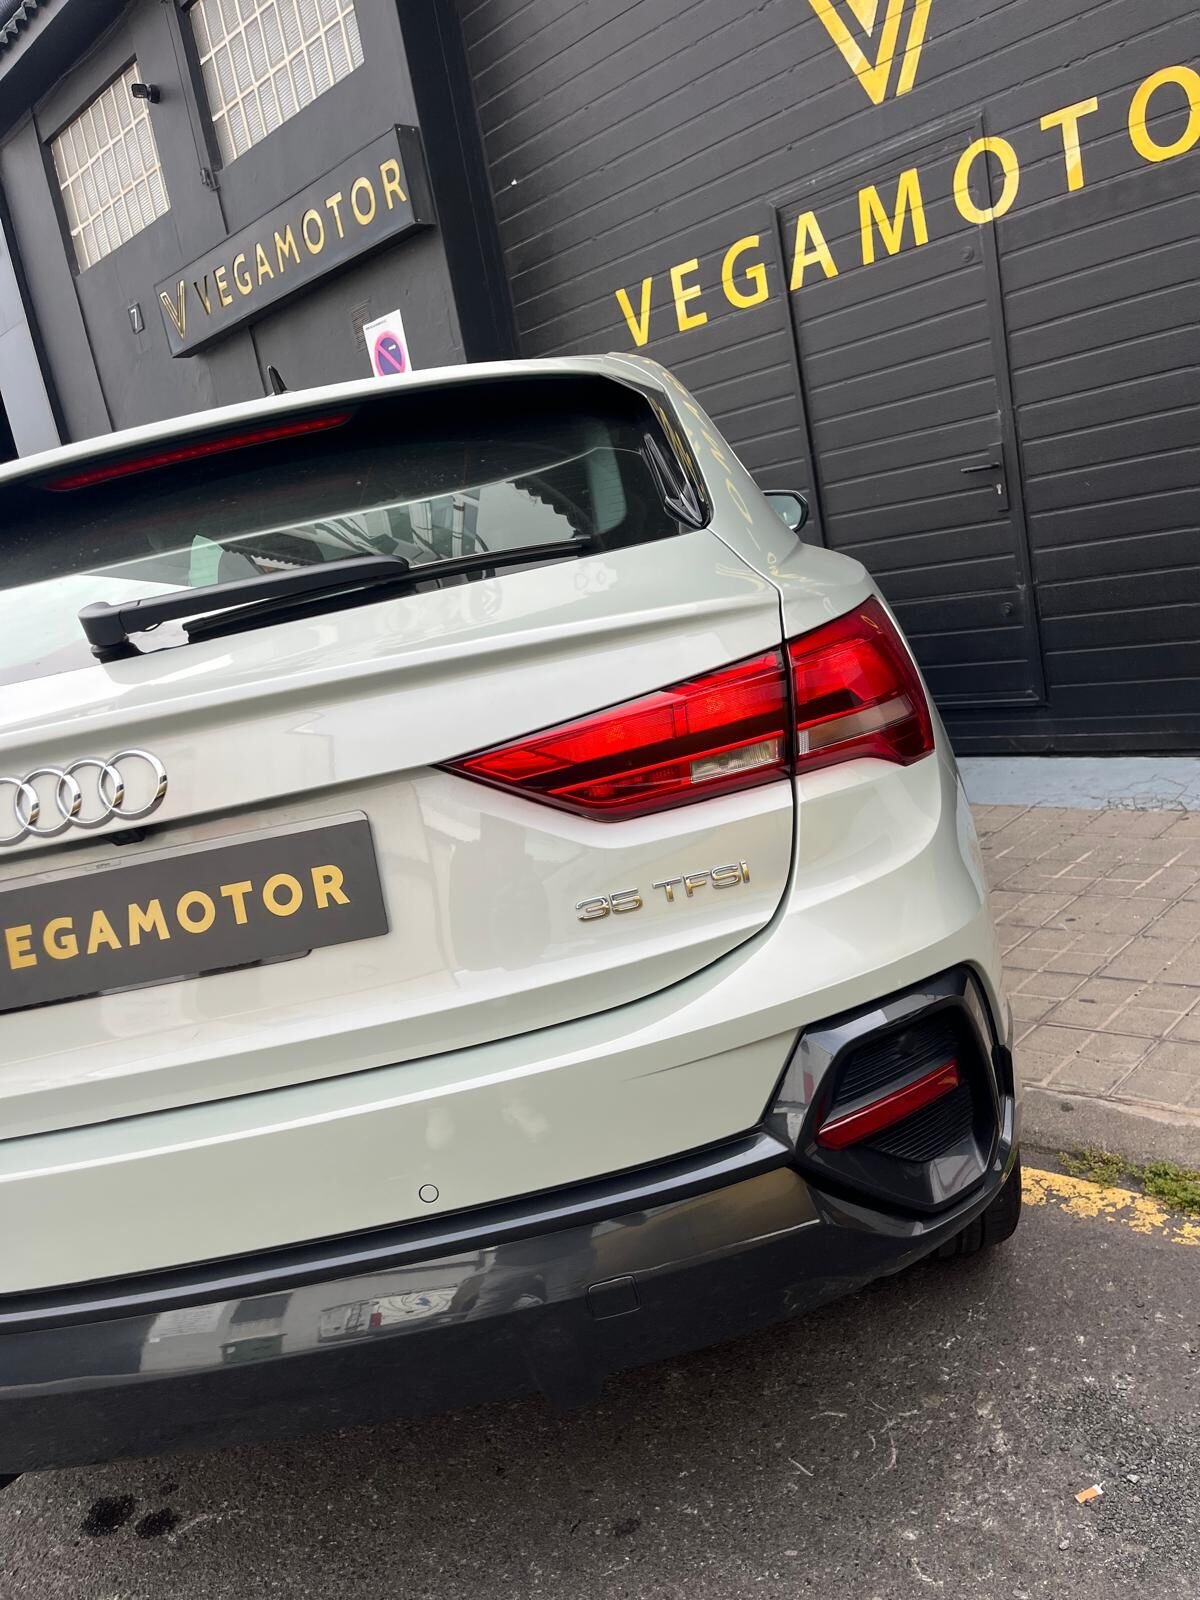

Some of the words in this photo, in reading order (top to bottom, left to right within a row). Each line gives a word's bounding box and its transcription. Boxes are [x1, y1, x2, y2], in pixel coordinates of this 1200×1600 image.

[194, 158, 407, 316] VEGAMOTOR
[615, 65, 1200, 347] VEGAMOTO
[5, 864, 351, 970] EGAMOTOR
[576, 888, 643, 921] 35
[652, 859, 750, 902] TFSI
